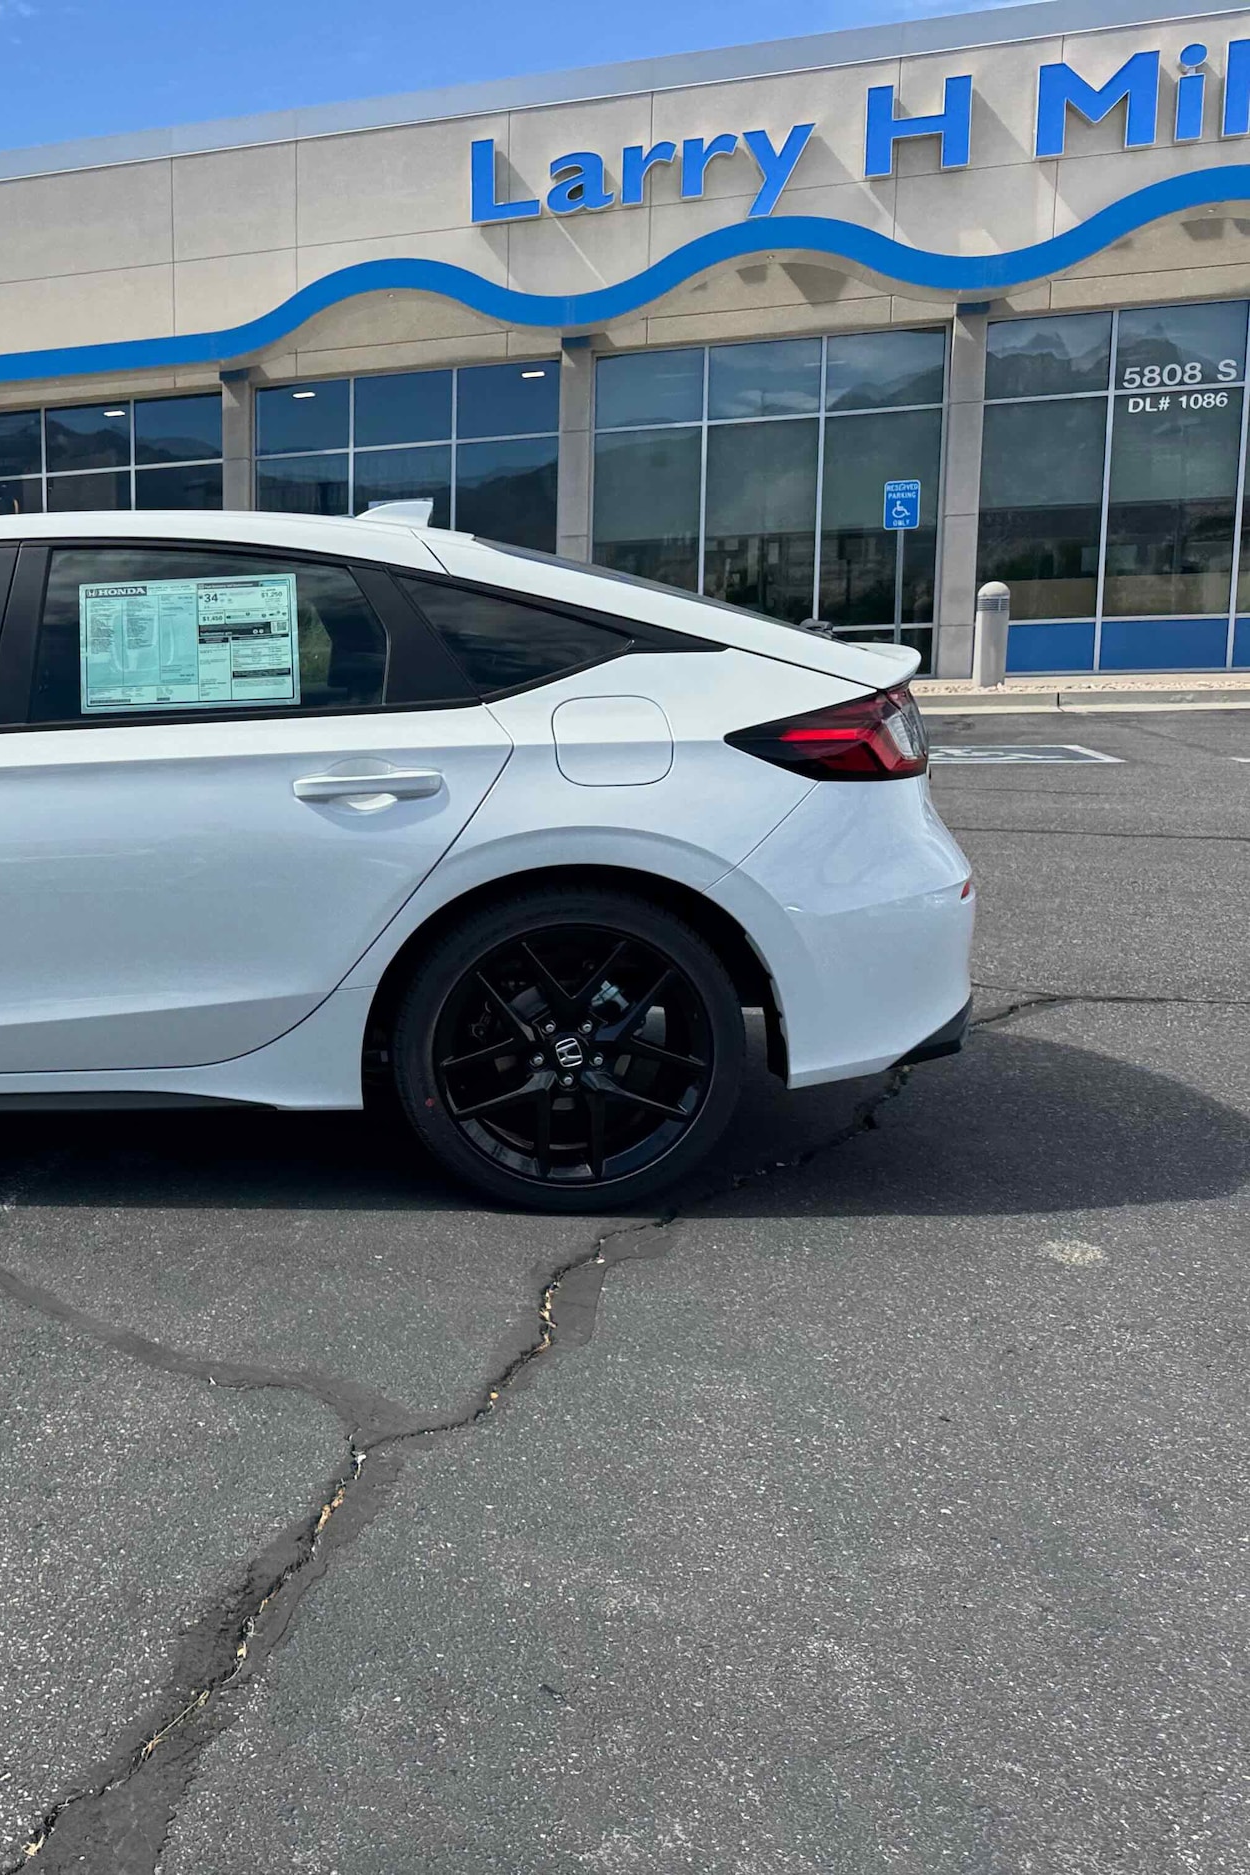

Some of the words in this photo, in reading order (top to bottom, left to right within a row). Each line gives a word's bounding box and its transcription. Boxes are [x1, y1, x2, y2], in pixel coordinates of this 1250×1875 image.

[470, 123, 816, 225] Larry
[864, 75, 973, 179] H
[1122, 361, 1202, 388] 5808
[1216, 358, 1238, 382] S
[1128, 395, 1170, 413] DL#
[1178, 391, 1229, 410] 1086
[886, 483, 918, 491] RESERVED
[888, 491, 916, 499] PARKING
[98, 587, 146, 596] HONDA
[204, 593, 218, 603] 34
